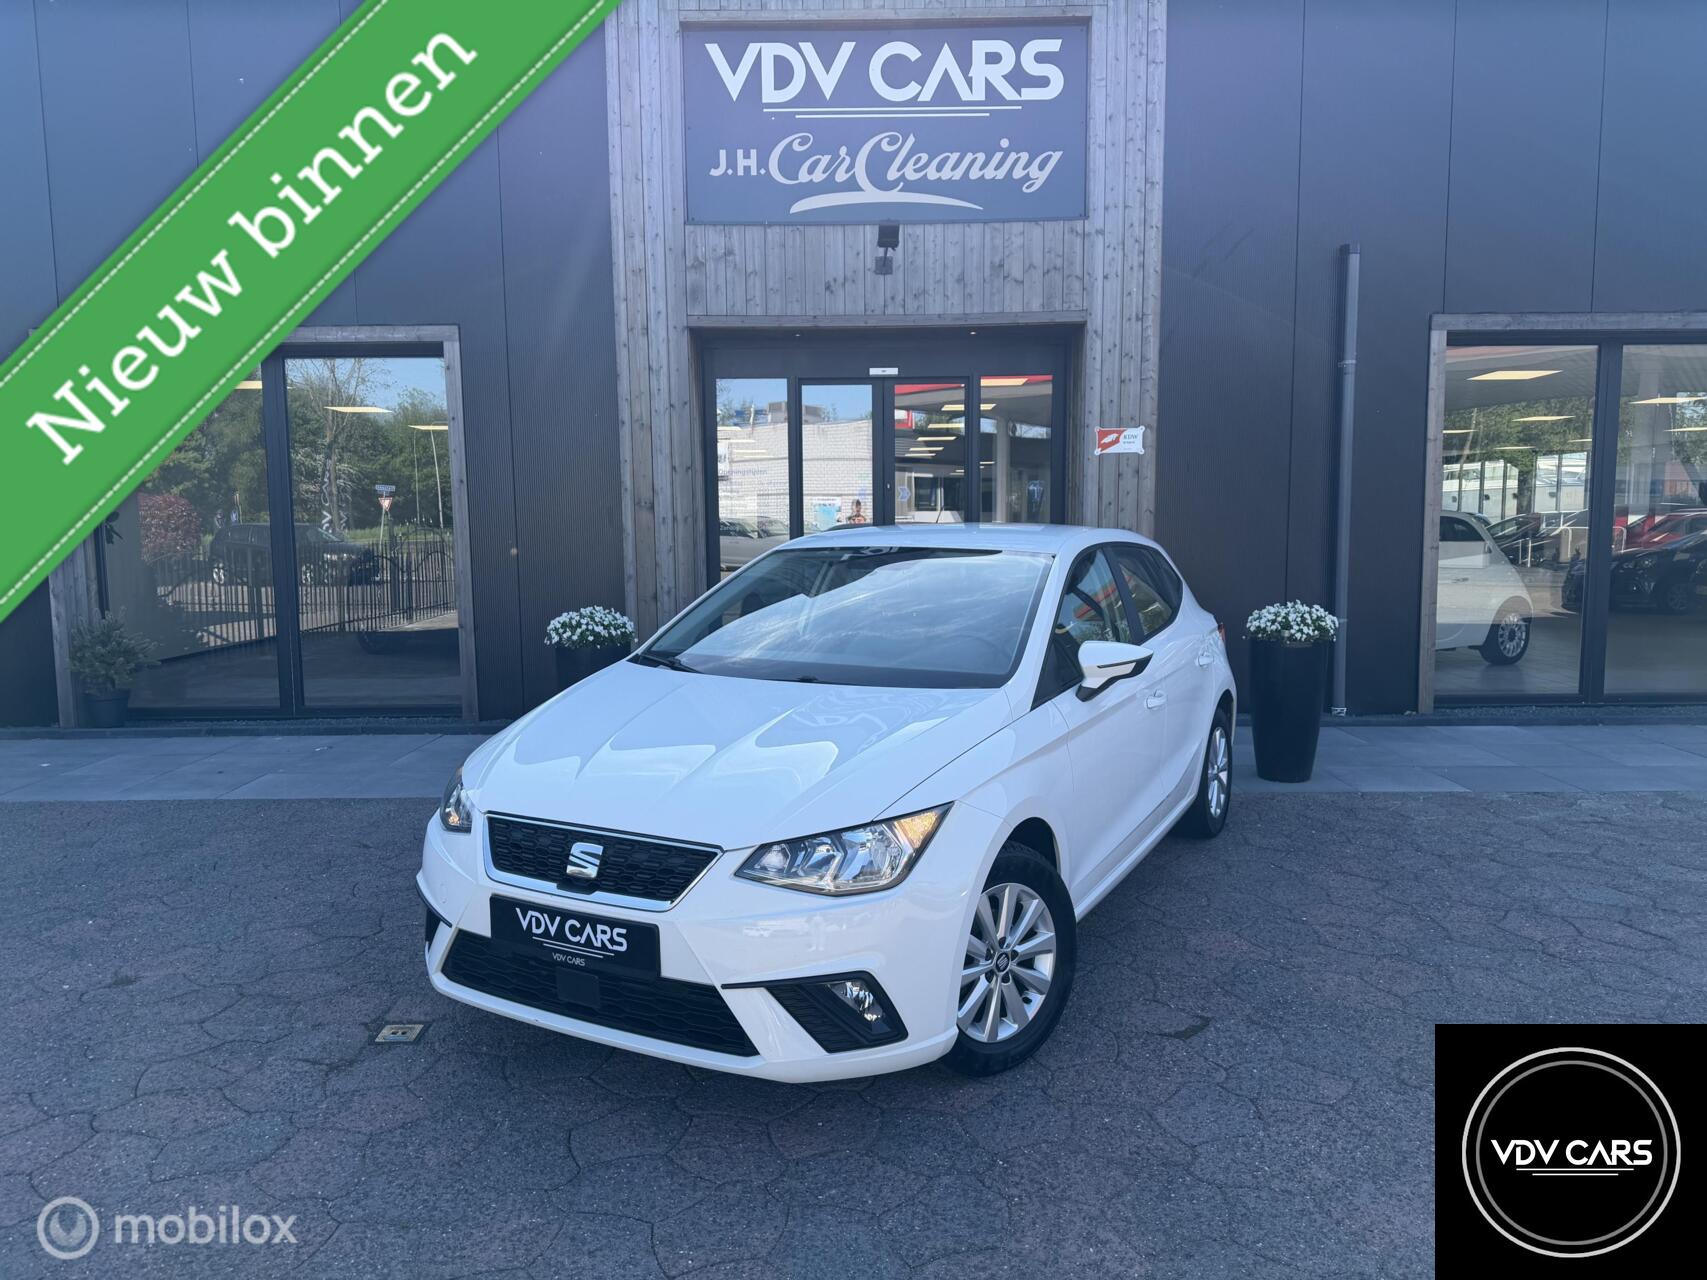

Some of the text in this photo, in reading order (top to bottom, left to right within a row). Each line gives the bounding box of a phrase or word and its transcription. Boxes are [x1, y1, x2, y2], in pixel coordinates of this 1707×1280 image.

[705, 39, 1064, 103] VDV CARS
[709, 148, 766, 176] J.H.
[516, 907, 628, 952] VDV CARS
[552, 952, 585, 967] VDV CARS
